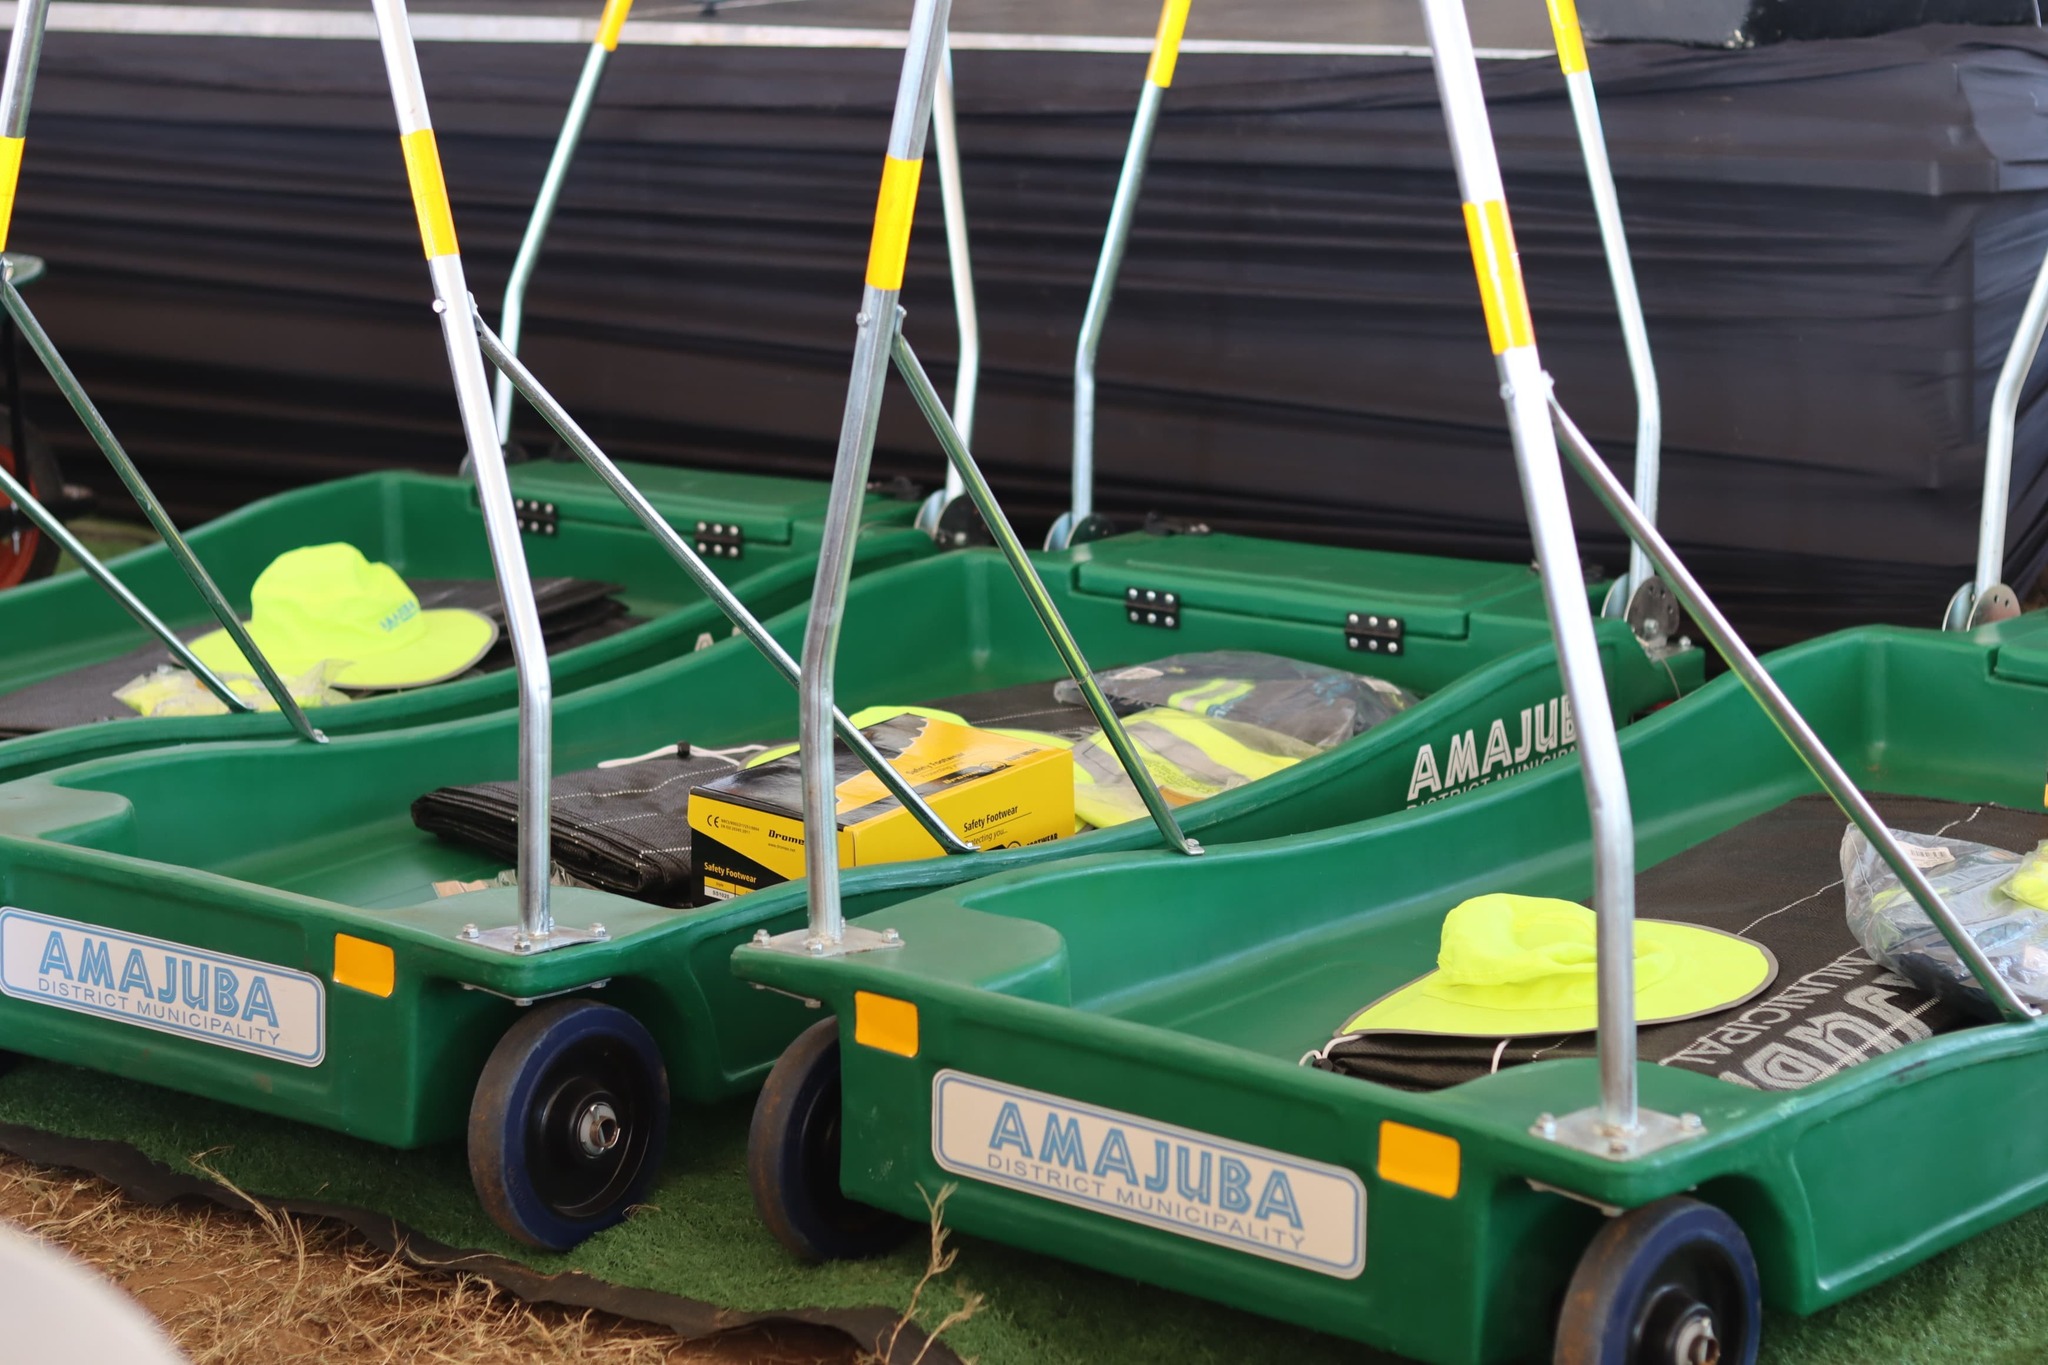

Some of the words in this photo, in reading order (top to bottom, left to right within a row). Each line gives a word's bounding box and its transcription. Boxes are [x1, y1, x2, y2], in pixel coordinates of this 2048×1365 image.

[1407, 694, 1577, 801] AMAJUB
[768, 829, 805, 846] Drome
[963, 818, 986, 833] Safety
[986, 805, 1019, 825] Footwear
[964, 833, 993, 846] tecting
[704, 862, 725, 876] Safety
[726, 867, 757, 884] Footwear
[38, 931, 279, 1028] AMAJUBA
[38, 978, 129, 1010] DISTRICT
[137, 1001, 281, 1046] MUNICIPALITY
[988, 1101, 1303, 1229] AMAJUBA
[988, 1153, 1105, 1197] DISTRICT
[1116, 1187, 1306, 1250] MUNICIPALITY
